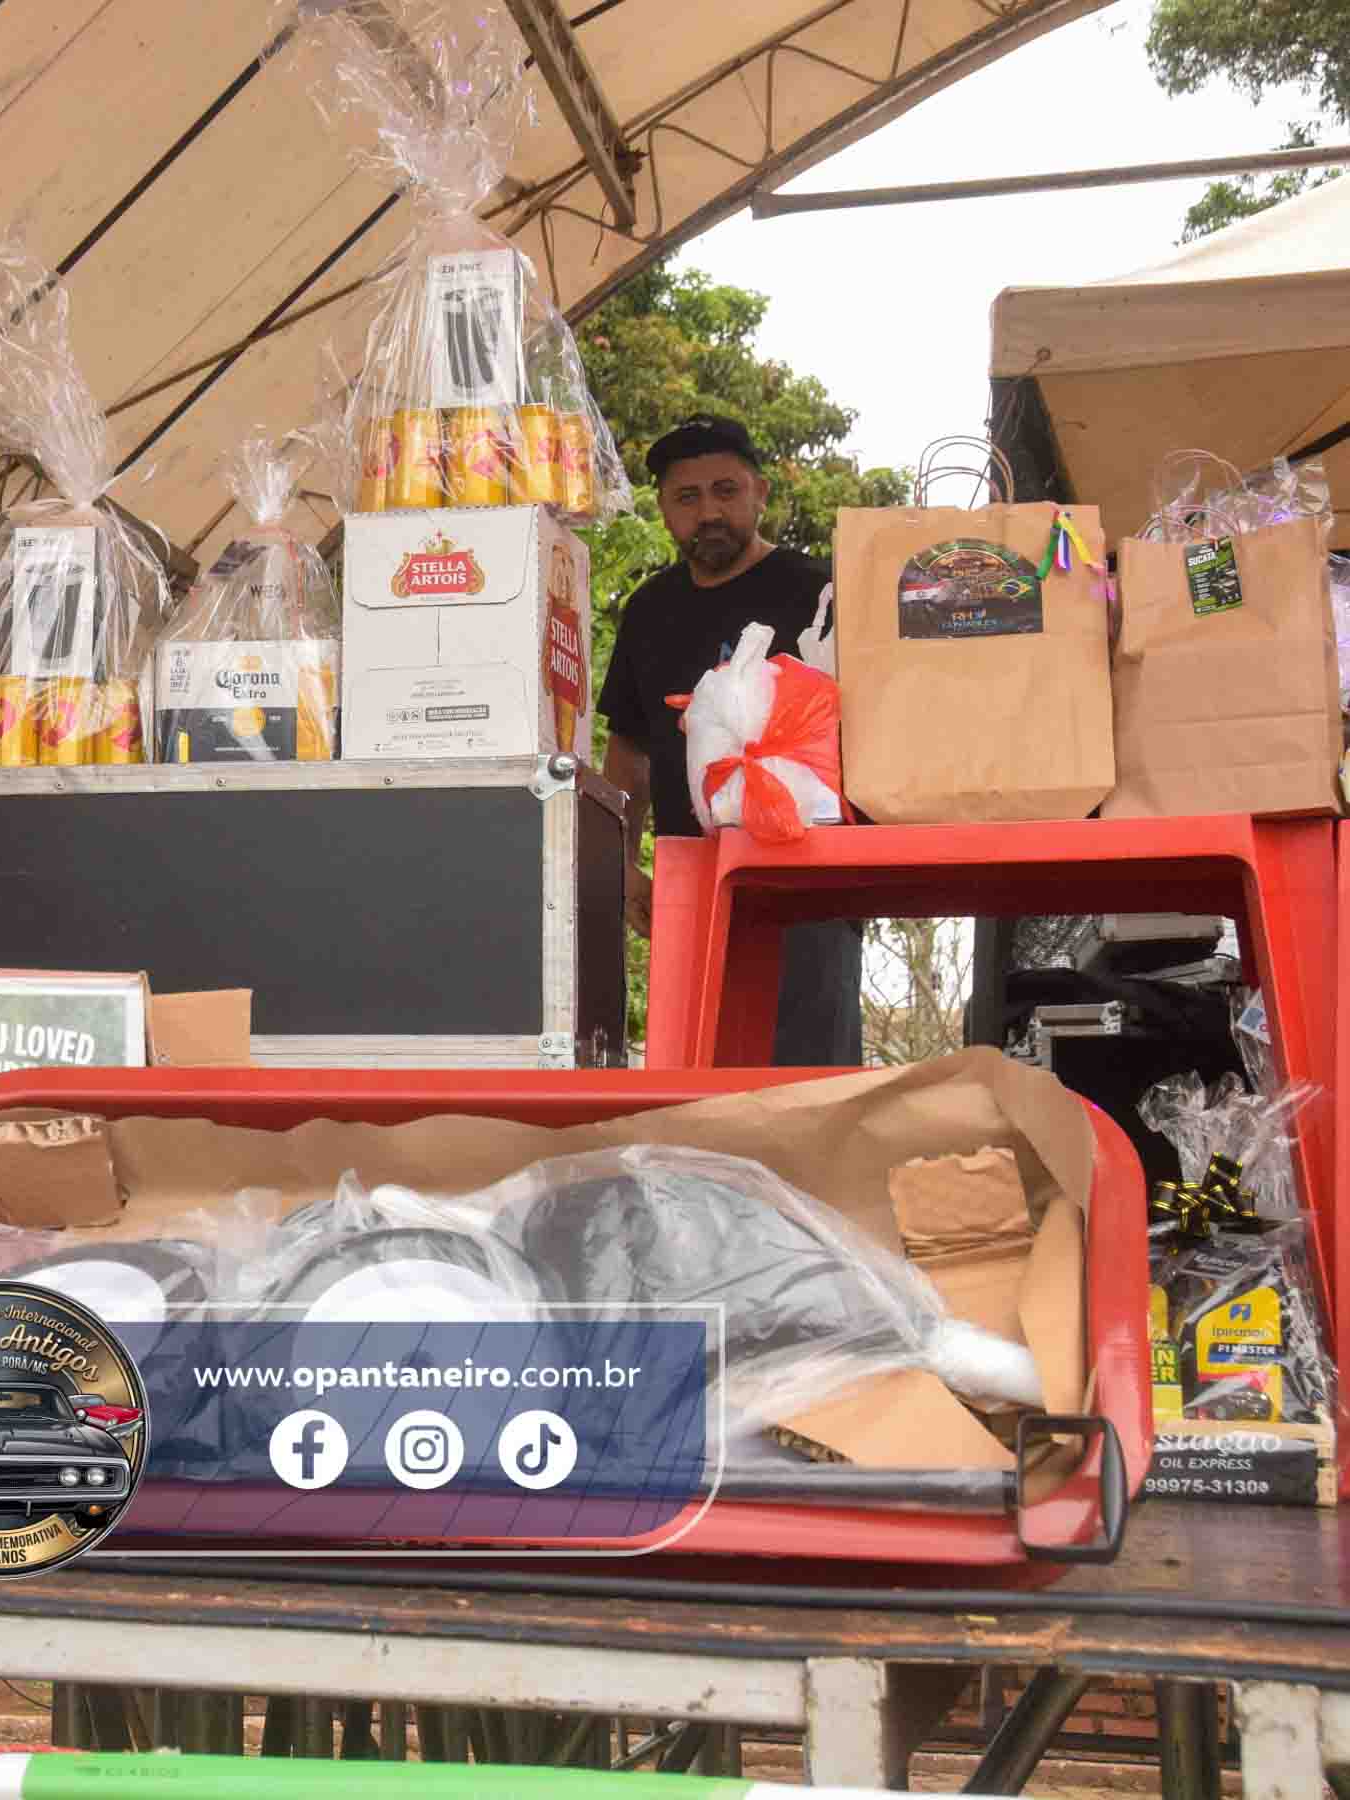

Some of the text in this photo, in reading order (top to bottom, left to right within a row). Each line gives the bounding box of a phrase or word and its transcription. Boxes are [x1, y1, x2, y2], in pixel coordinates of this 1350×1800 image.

[410, 560, 468, 574] STELLA
[410, 573, 468, 586] ARTOIS
[551, 615, 579, 657] STELLA
[550, 648, 579, 687] ARTOIS
[216, 671, 283, 691] Corona
[14, 1024, 95, 1065] LOVED
[1159, 1457, 1253, 1471] OIL EXPRESS
